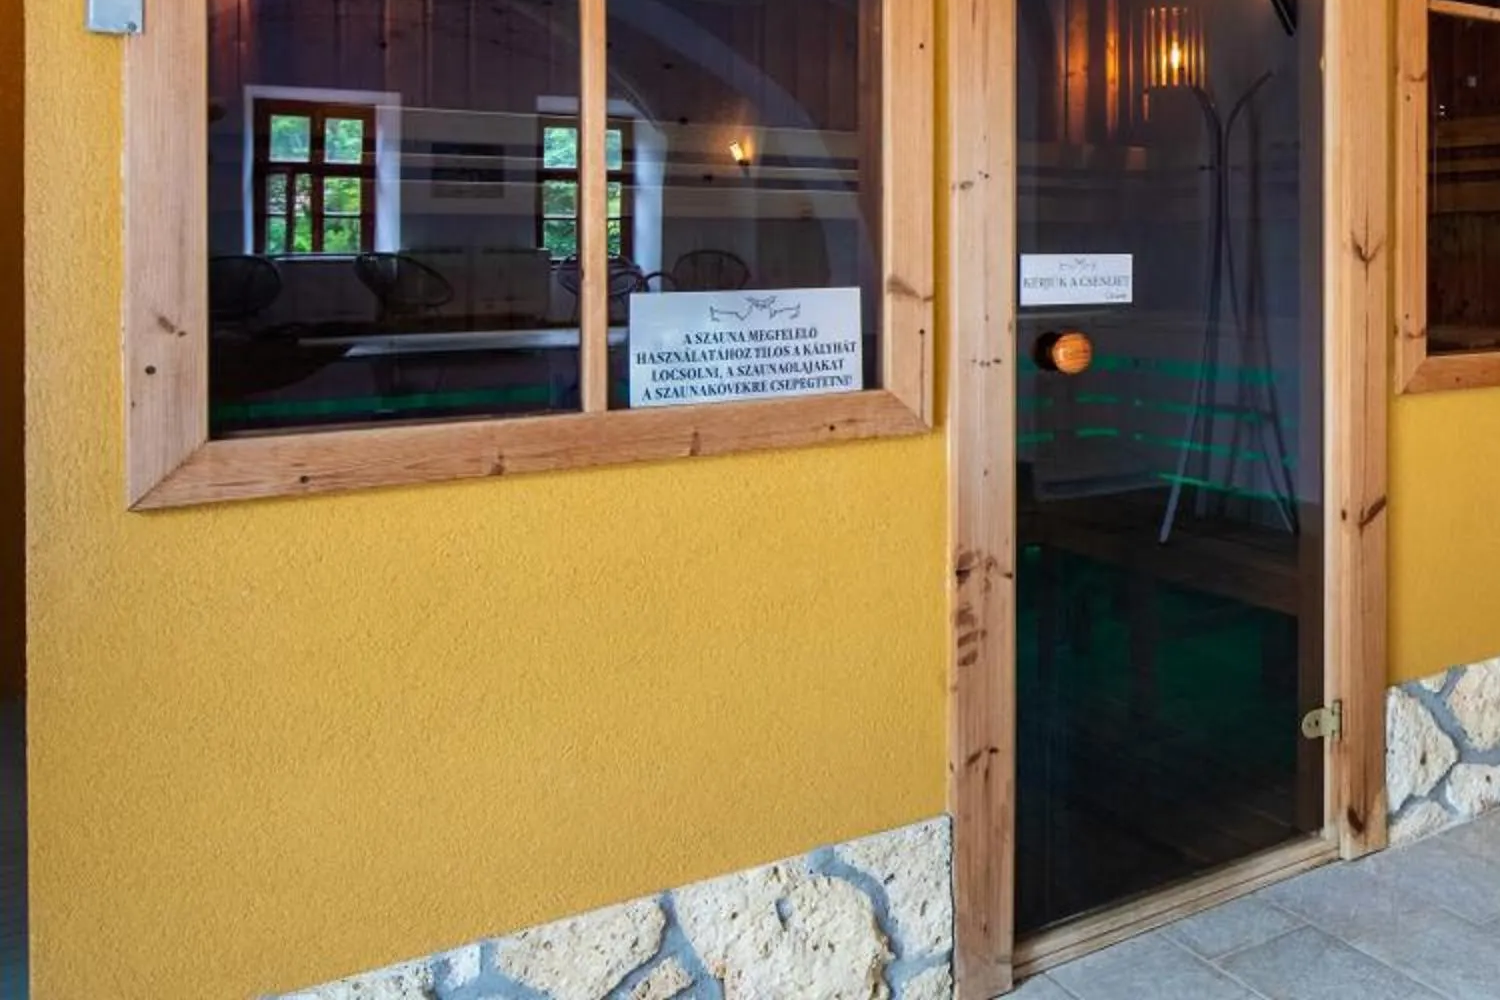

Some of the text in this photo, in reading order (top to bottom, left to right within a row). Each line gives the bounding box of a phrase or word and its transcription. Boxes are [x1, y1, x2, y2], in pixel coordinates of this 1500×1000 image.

[683, 333, 692, 345] A
[695, 331, 745, 345] SZAUNA
[755, 344, 792, 359] TILOS
[793, 344, 801, 357] A
[727, 366, 734, 377] A
[642, 387, 651, 400] A
